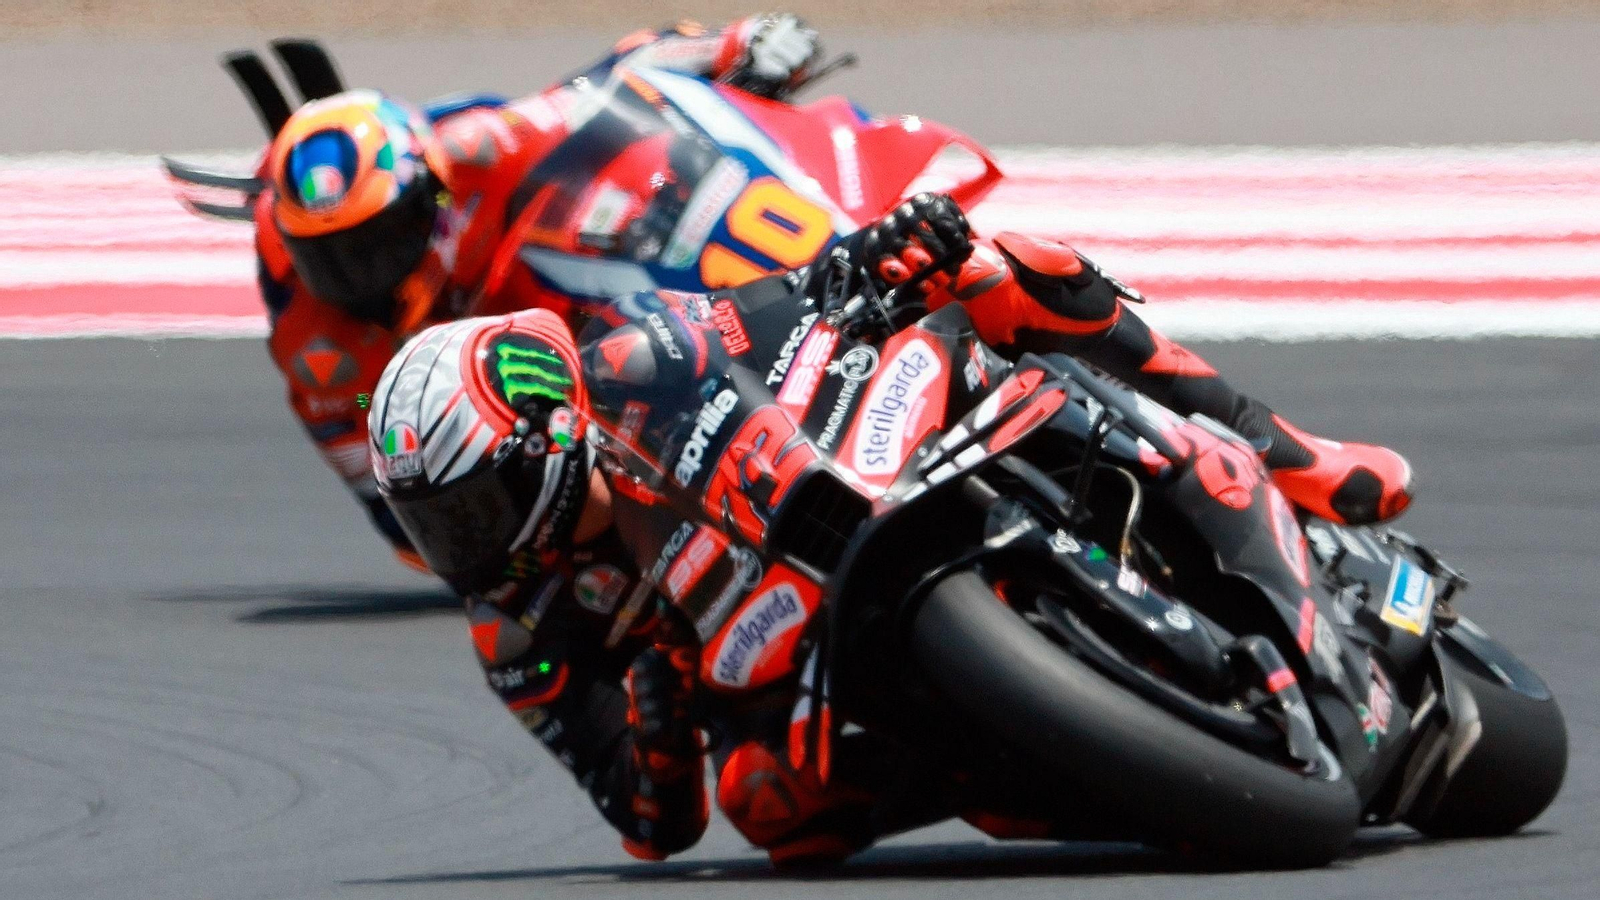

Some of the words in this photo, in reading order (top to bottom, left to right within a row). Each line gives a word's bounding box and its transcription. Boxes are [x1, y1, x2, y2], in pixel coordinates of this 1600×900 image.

[700, 174, 834, 290] 10
[765, 312, 820, 385] TARGA
[782, 328, 832, 405] BS
[674, 389, 739, 488] aprilia
[816, 379, 858, 449] PRAGMATIC
[864, 351, 930, 468] sterilgarda
[719, 590, 798, 684] sterilgarda
